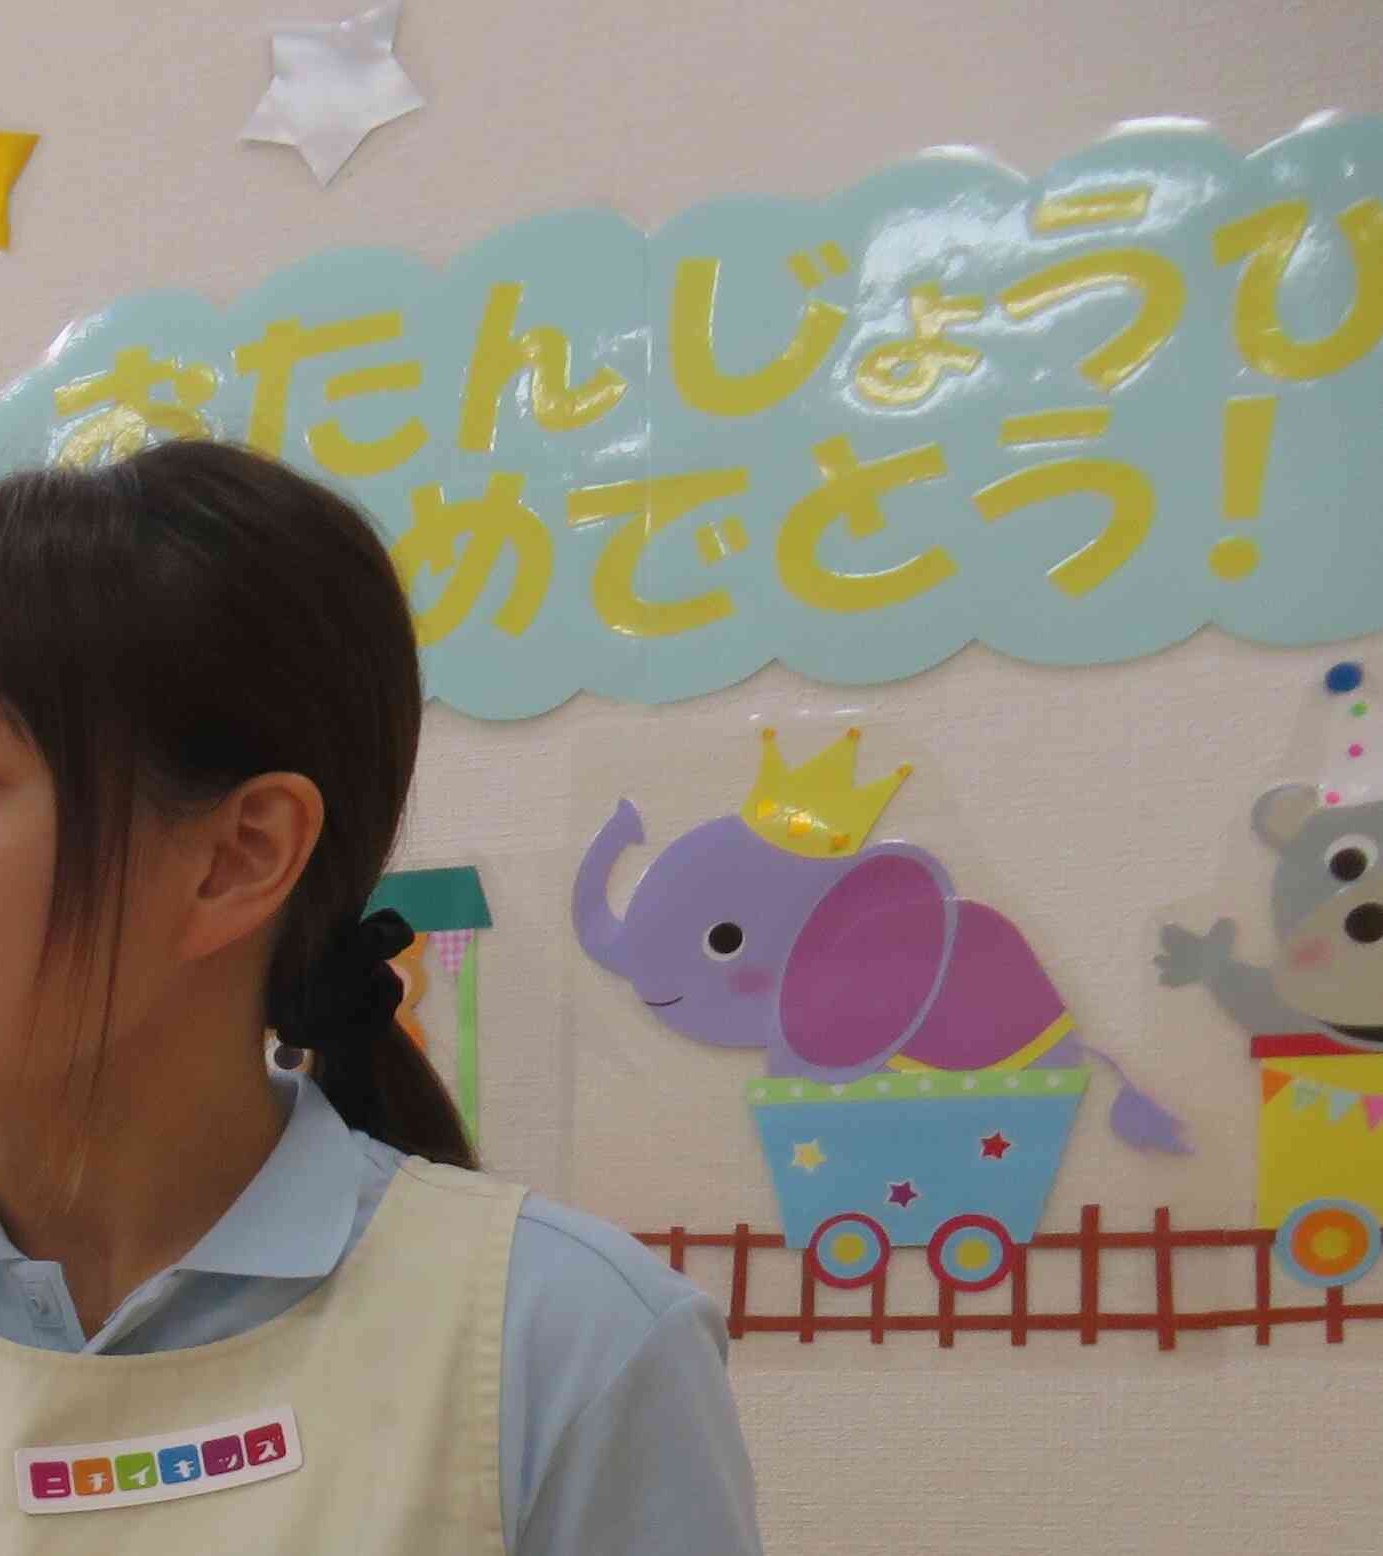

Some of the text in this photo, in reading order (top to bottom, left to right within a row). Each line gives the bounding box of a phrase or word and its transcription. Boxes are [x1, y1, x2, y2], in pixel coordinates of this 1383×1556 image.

[43, 1430, 284, 1496] ニチイキッズ
